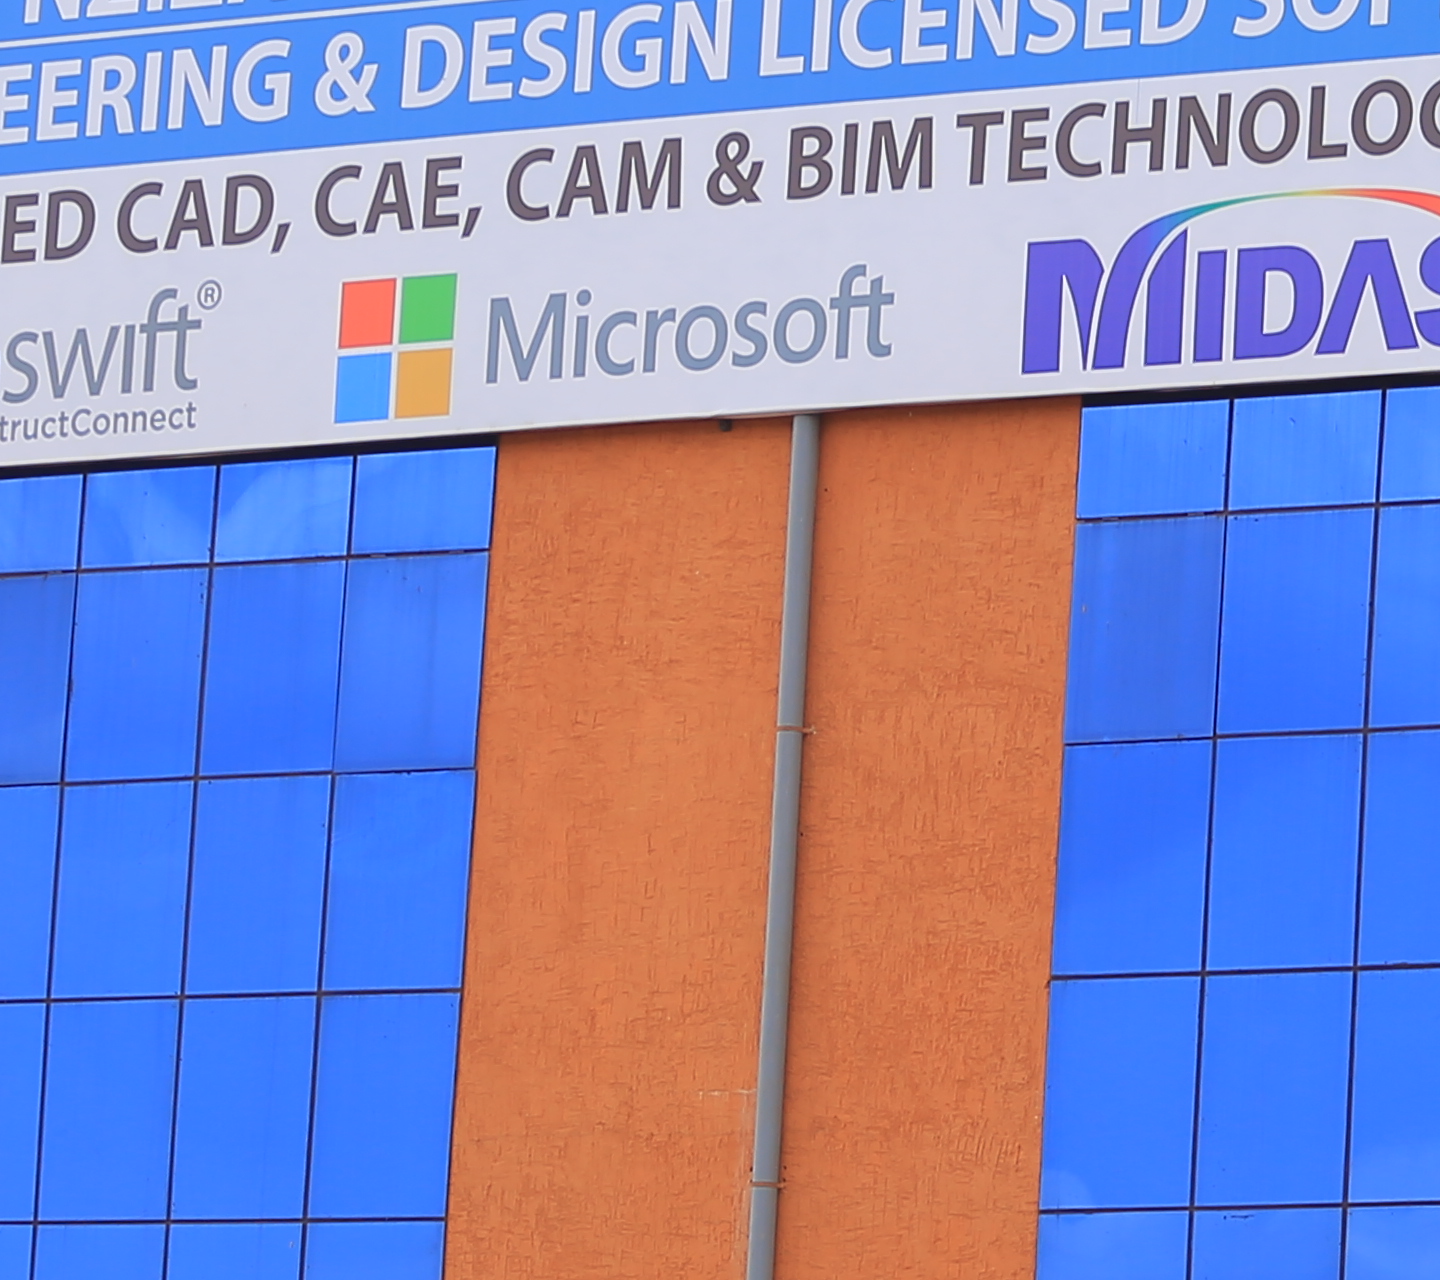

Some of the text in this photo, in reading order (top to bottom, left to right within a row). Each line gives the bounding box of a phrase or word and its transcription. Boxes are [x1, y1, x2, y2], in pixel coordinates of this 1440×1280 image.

[313, 32, 380, 116] &
[116, 173, 292, 255] CAD,
[314, 155, 483, 239] CAE,
[506, 136, 683, 222] CAM
[706, 131, 765, 207] &
[786, 115, 934, 201] BIM
[485, 263, 895, 384] Microsoft
